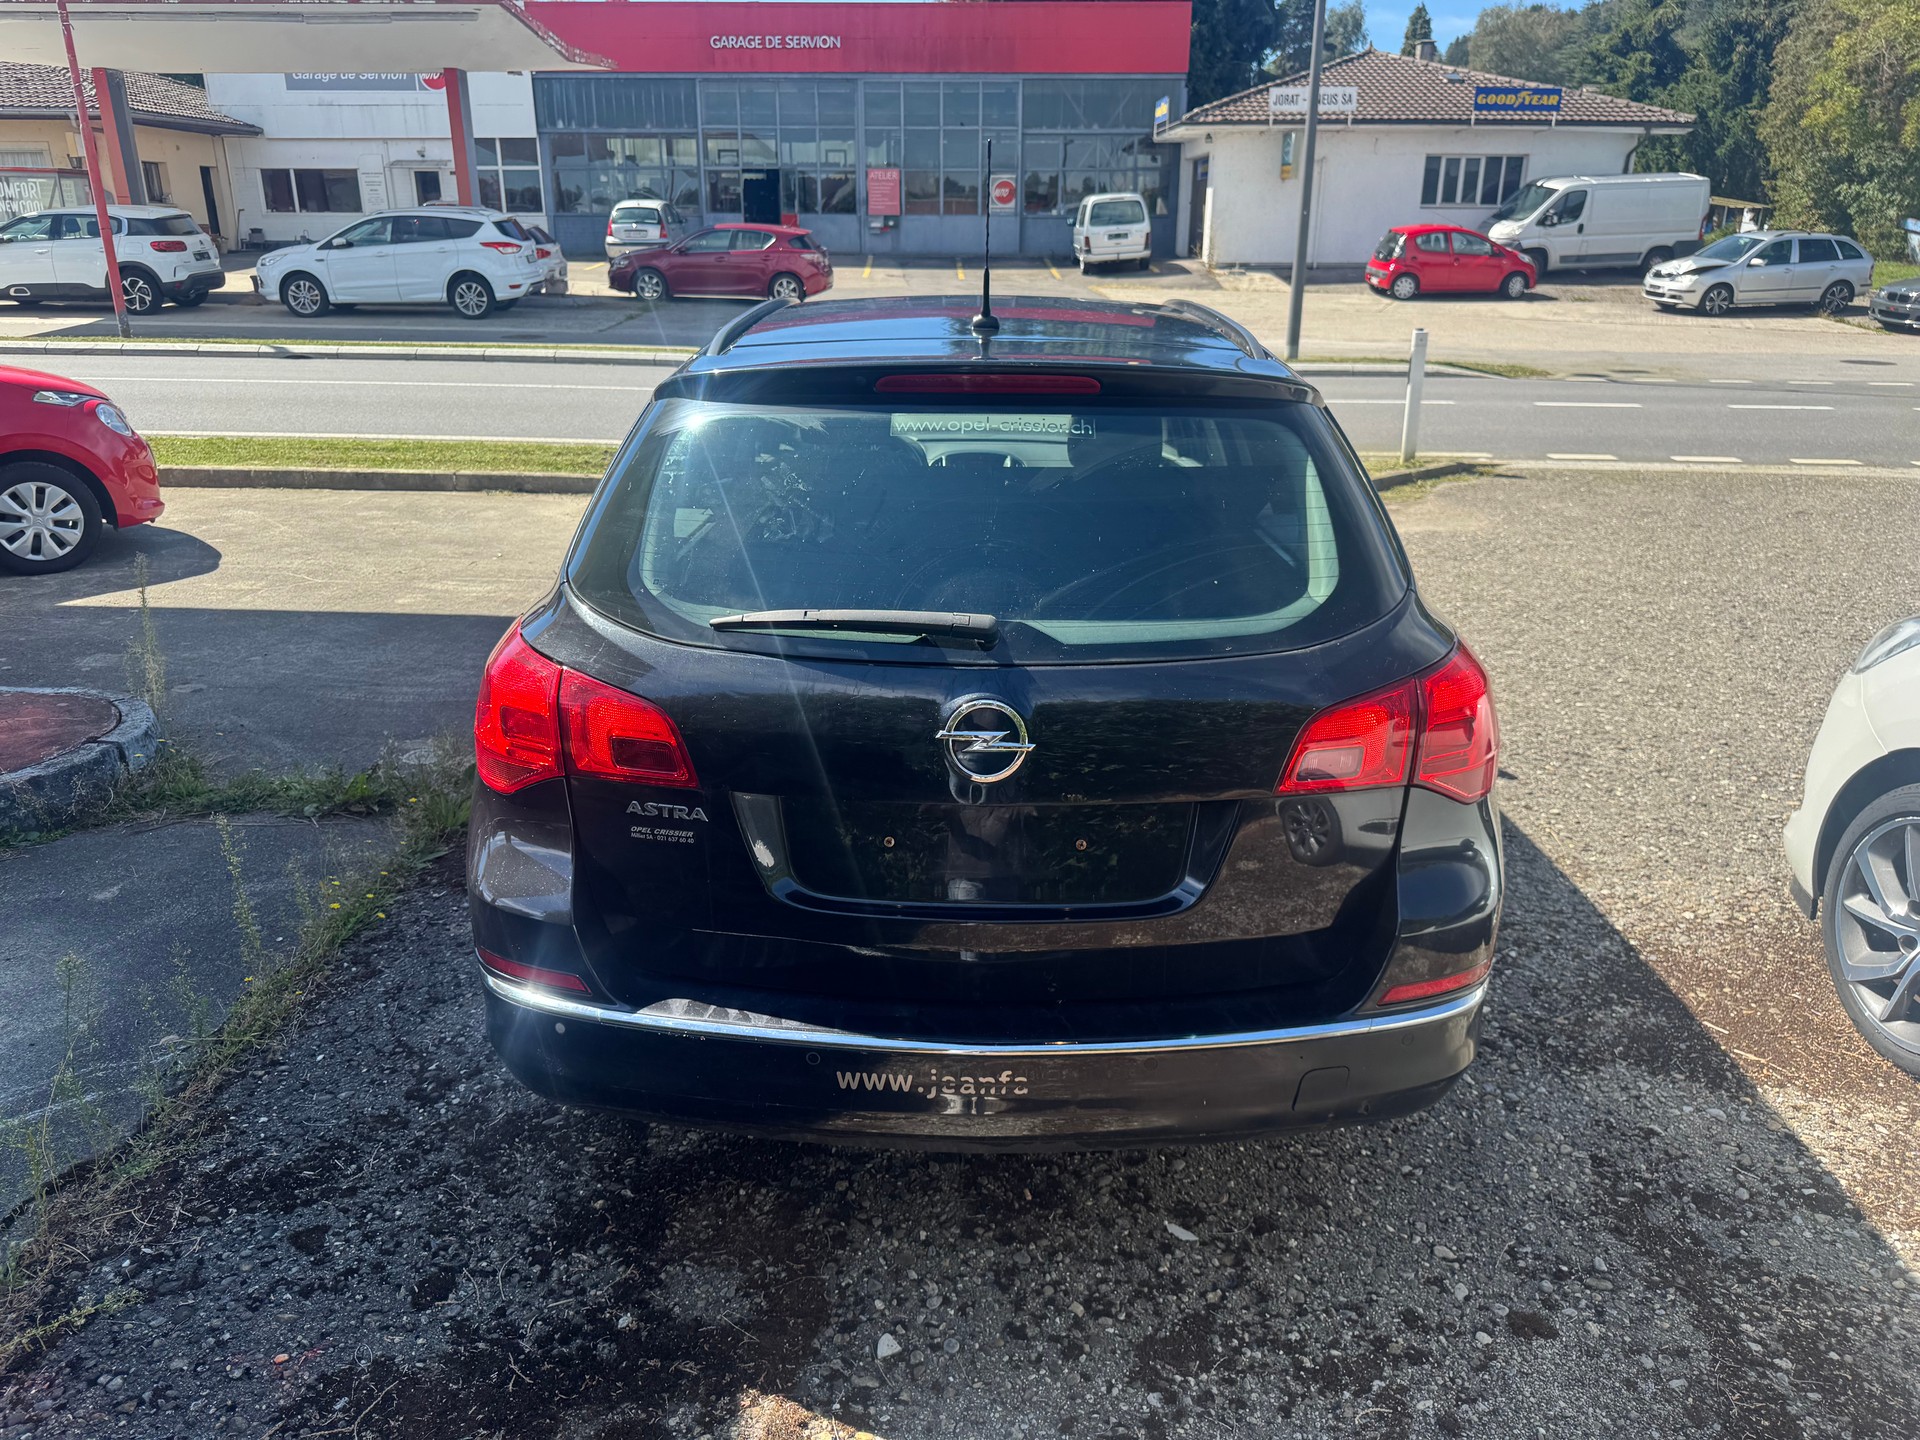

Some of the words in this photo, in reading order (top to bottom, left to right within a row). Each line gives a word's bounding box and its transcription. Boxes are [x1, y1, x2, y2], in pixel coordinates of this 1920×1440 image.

[710, 36, 762, 48] GARAGE
[765, 36, 782, 48] DE
[785, 36, 840, 48] SERVION
[292, 73, 337, 82] Garage
[1273, 94, 1299, 106] JORAT
[1341, 93, 1353, 105] SA
[1477, 91, 1559, 107] GOODYEAR
[894, 416, 1093, 434] www.opel-crissier.ch
[625, 800, 709, 822] ASTRA
[630, 826, 652, 834] OPEL
[654, 828, 694, 837] CRISSIER
